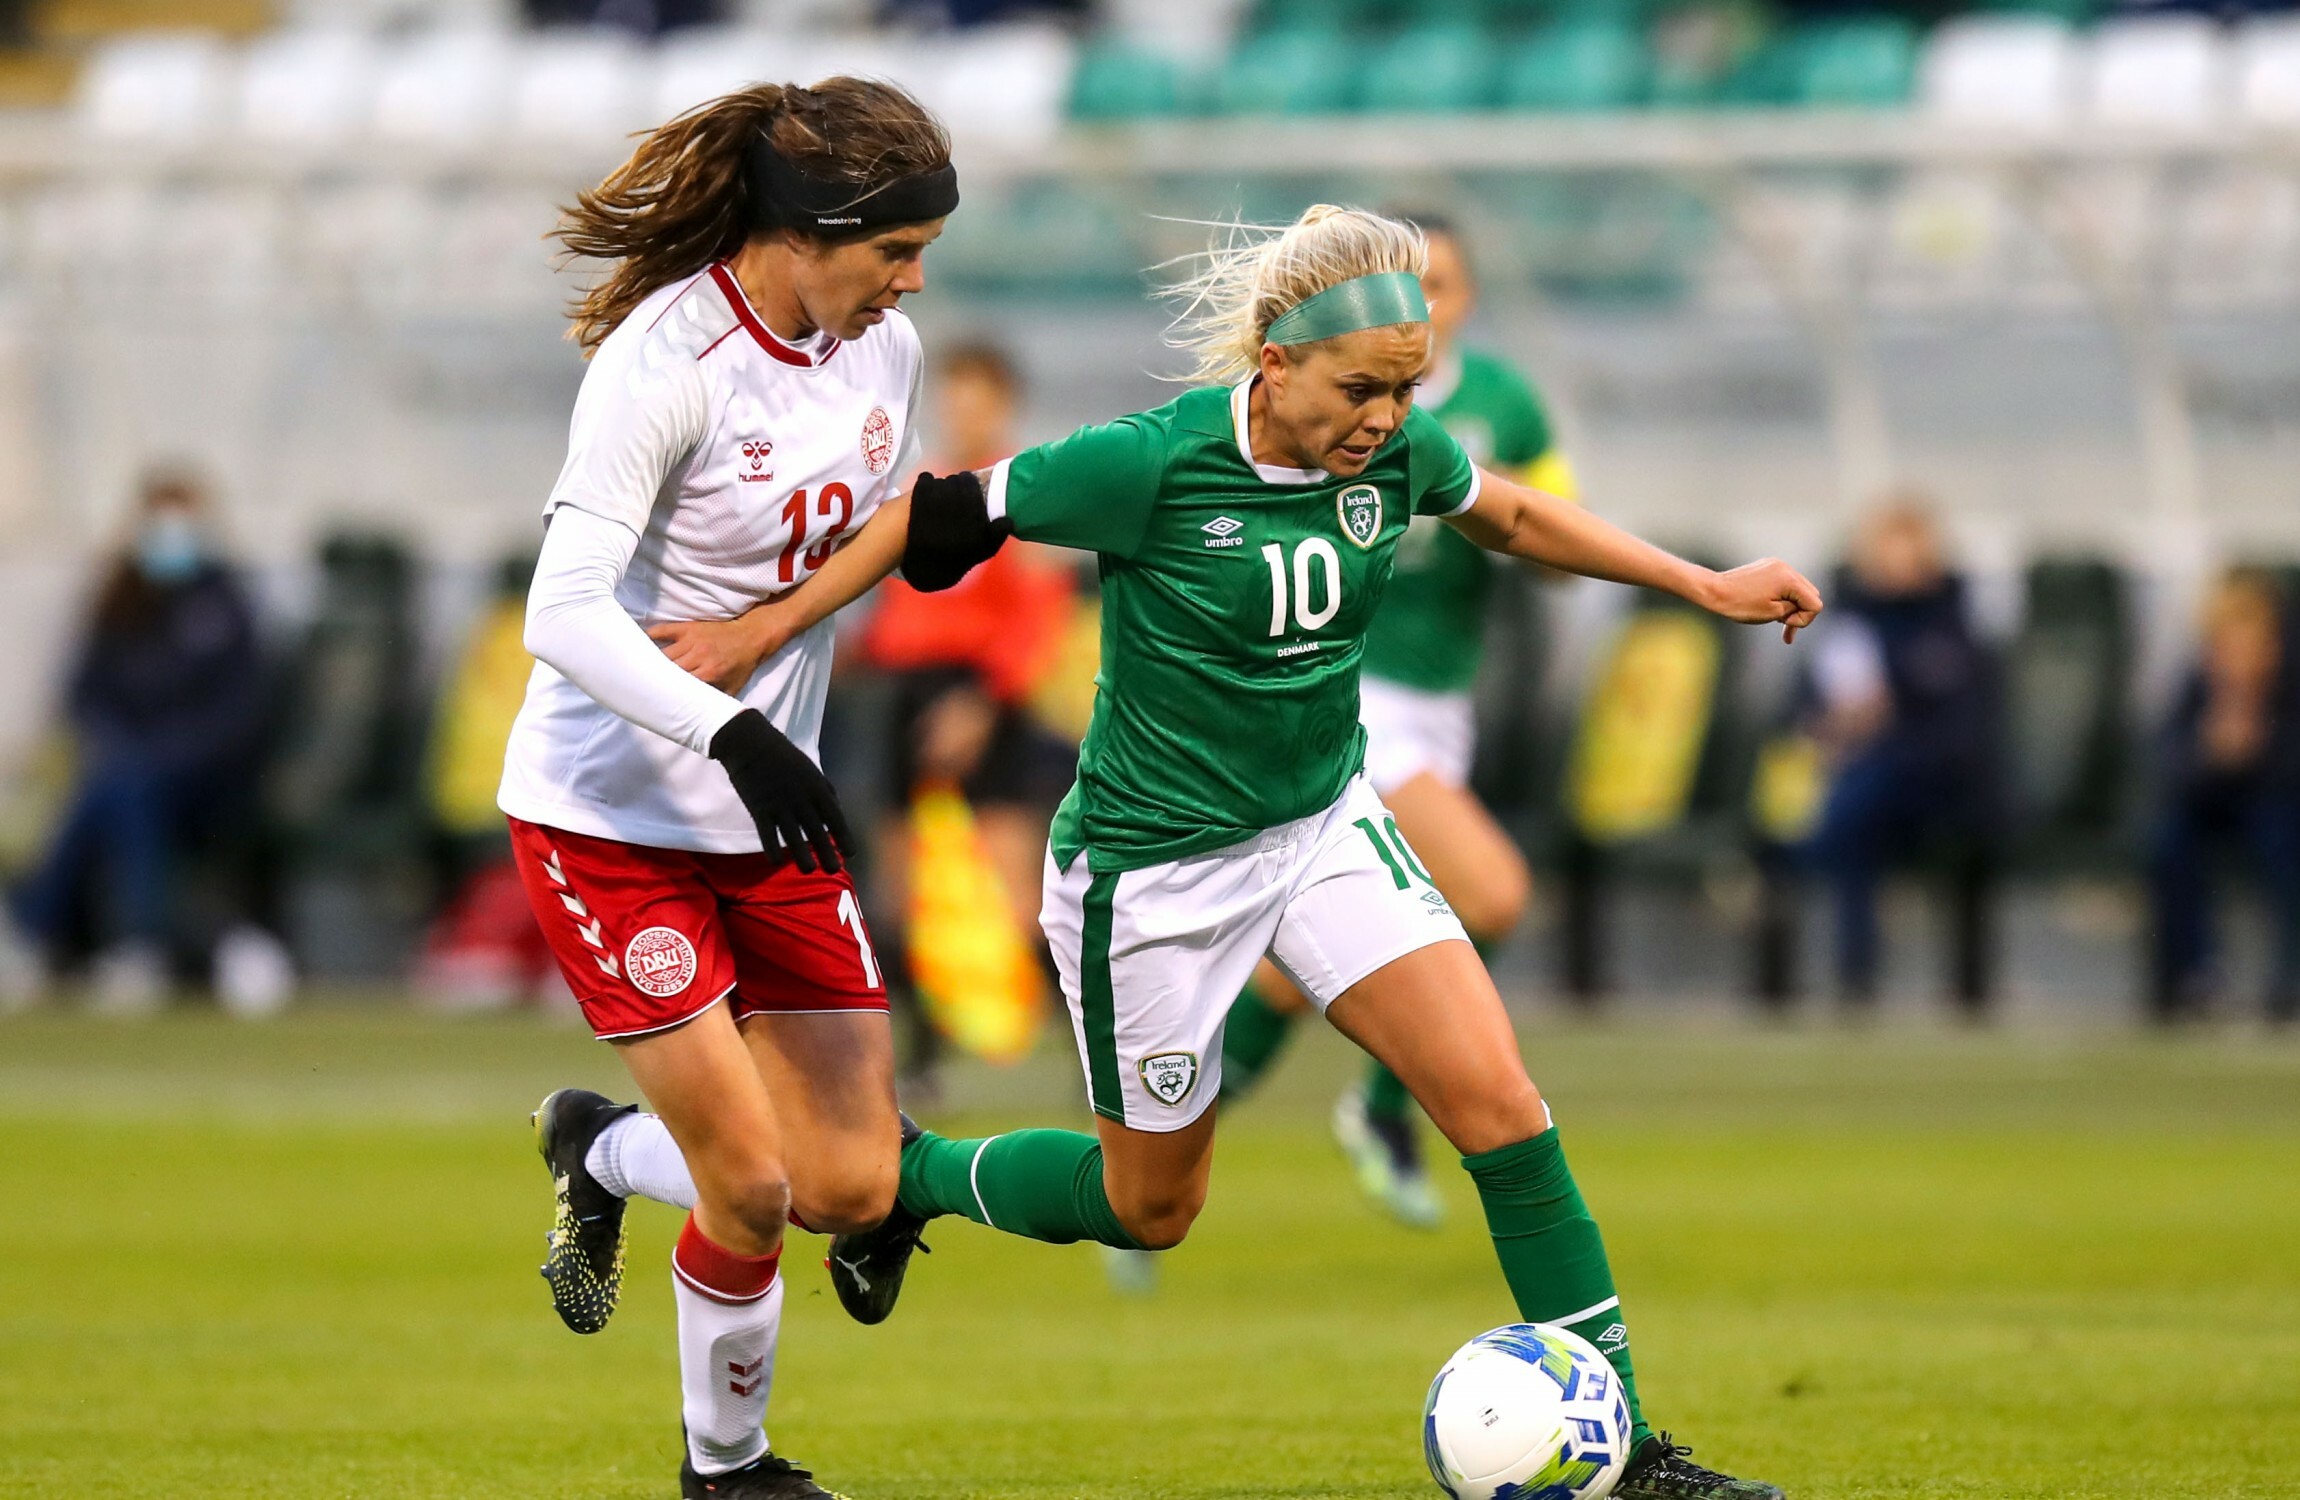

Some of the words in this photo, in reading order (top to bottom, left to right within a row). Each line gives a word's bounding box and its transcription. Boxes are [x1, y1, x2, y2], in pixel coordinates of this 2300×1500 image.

[868, 427, 887, 452] DBU
[738, 470, 774, 482] hummel
[1346, 493, 1373, 506] Ireland
[778, 481, 854, 583] 13
[1205, 536, 1243, 548] umbro
[1260, 536, 1342, 637] 10
[1277, 641, 1320, 657] DENMARK
[837, 889, 884, 989] 1
[640, 947, 682, 975] DBU
[630, 954, 654, 990] DANSK
[656, 979, 684, 993] 1889
[1151, 1059, 1186, 1070] Ireland
